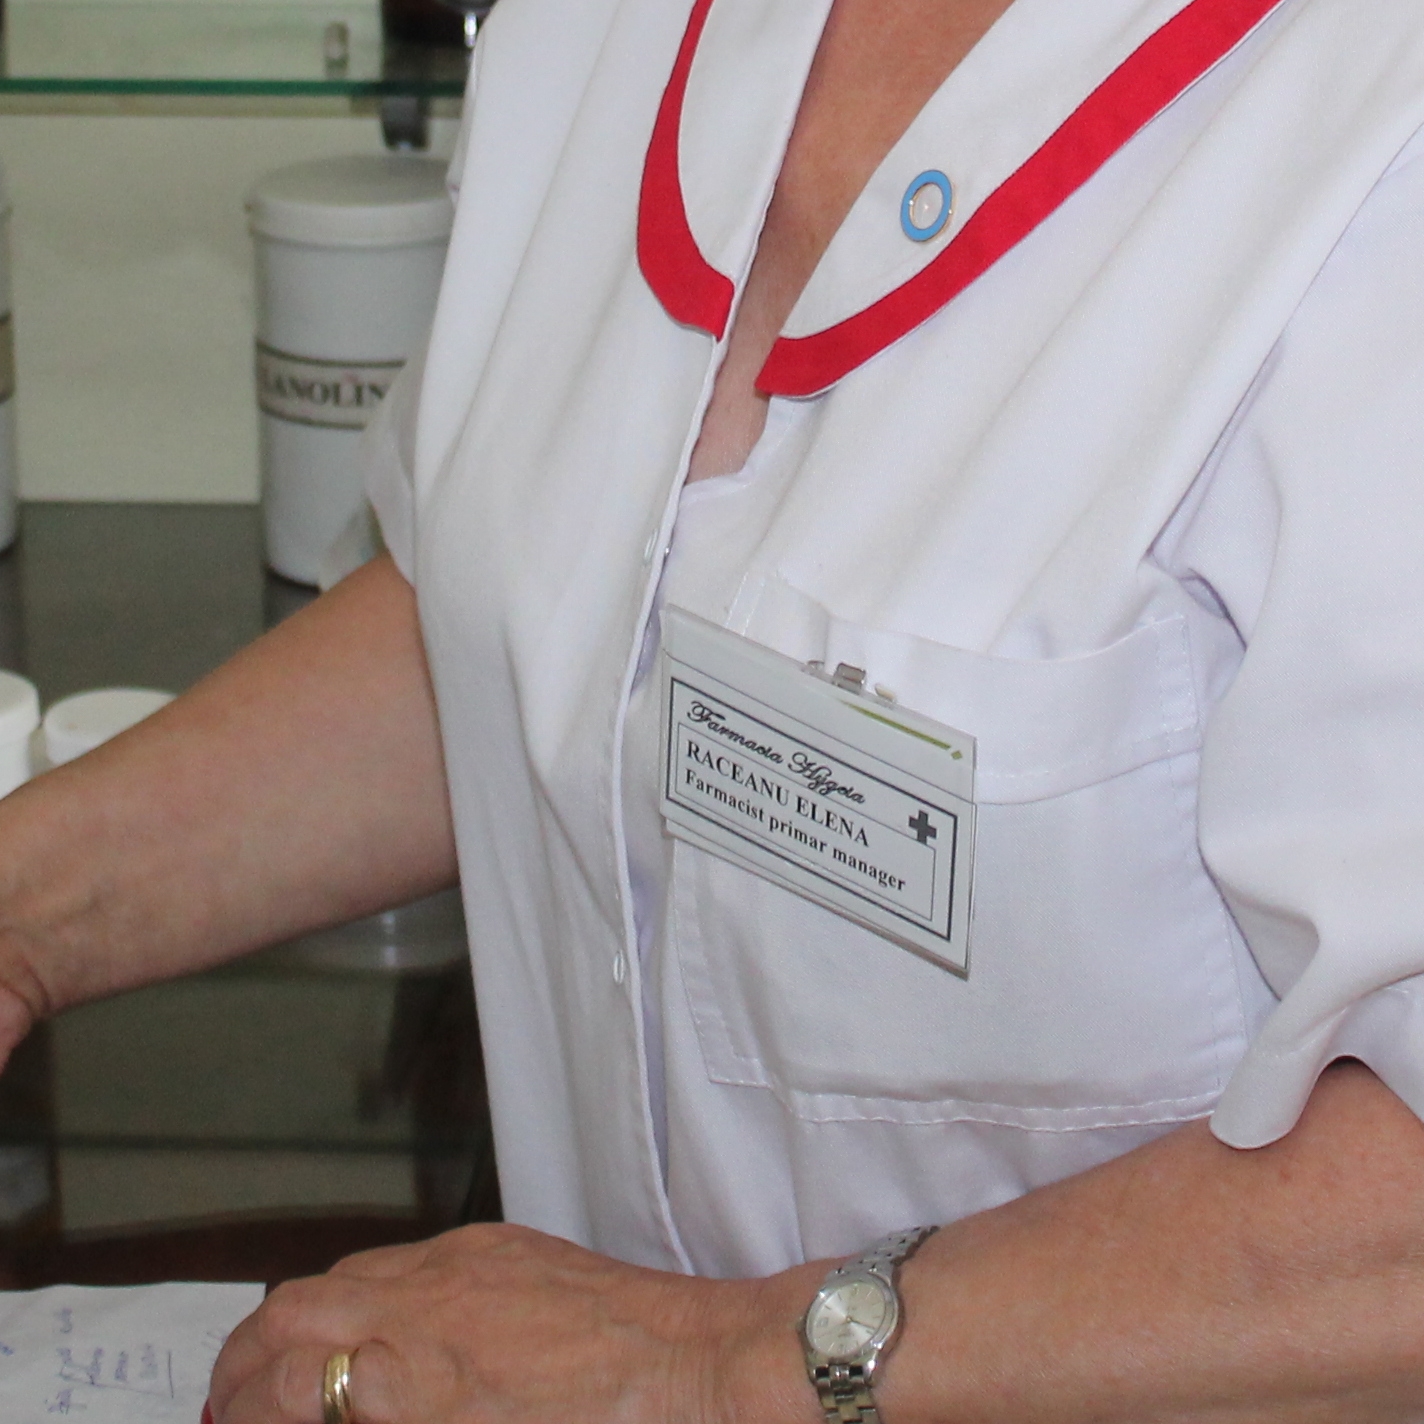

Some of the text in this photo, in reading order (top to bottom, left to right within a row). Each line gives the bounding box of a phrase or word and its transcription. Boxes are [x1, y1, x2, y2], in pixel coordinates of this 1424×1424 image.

[686, 700, 866, 805] Farmacia Hygeia
[686, 739, 870, 848] RACEANU ELENA
[685, 767, 906, 892] Farmacist primar manager
